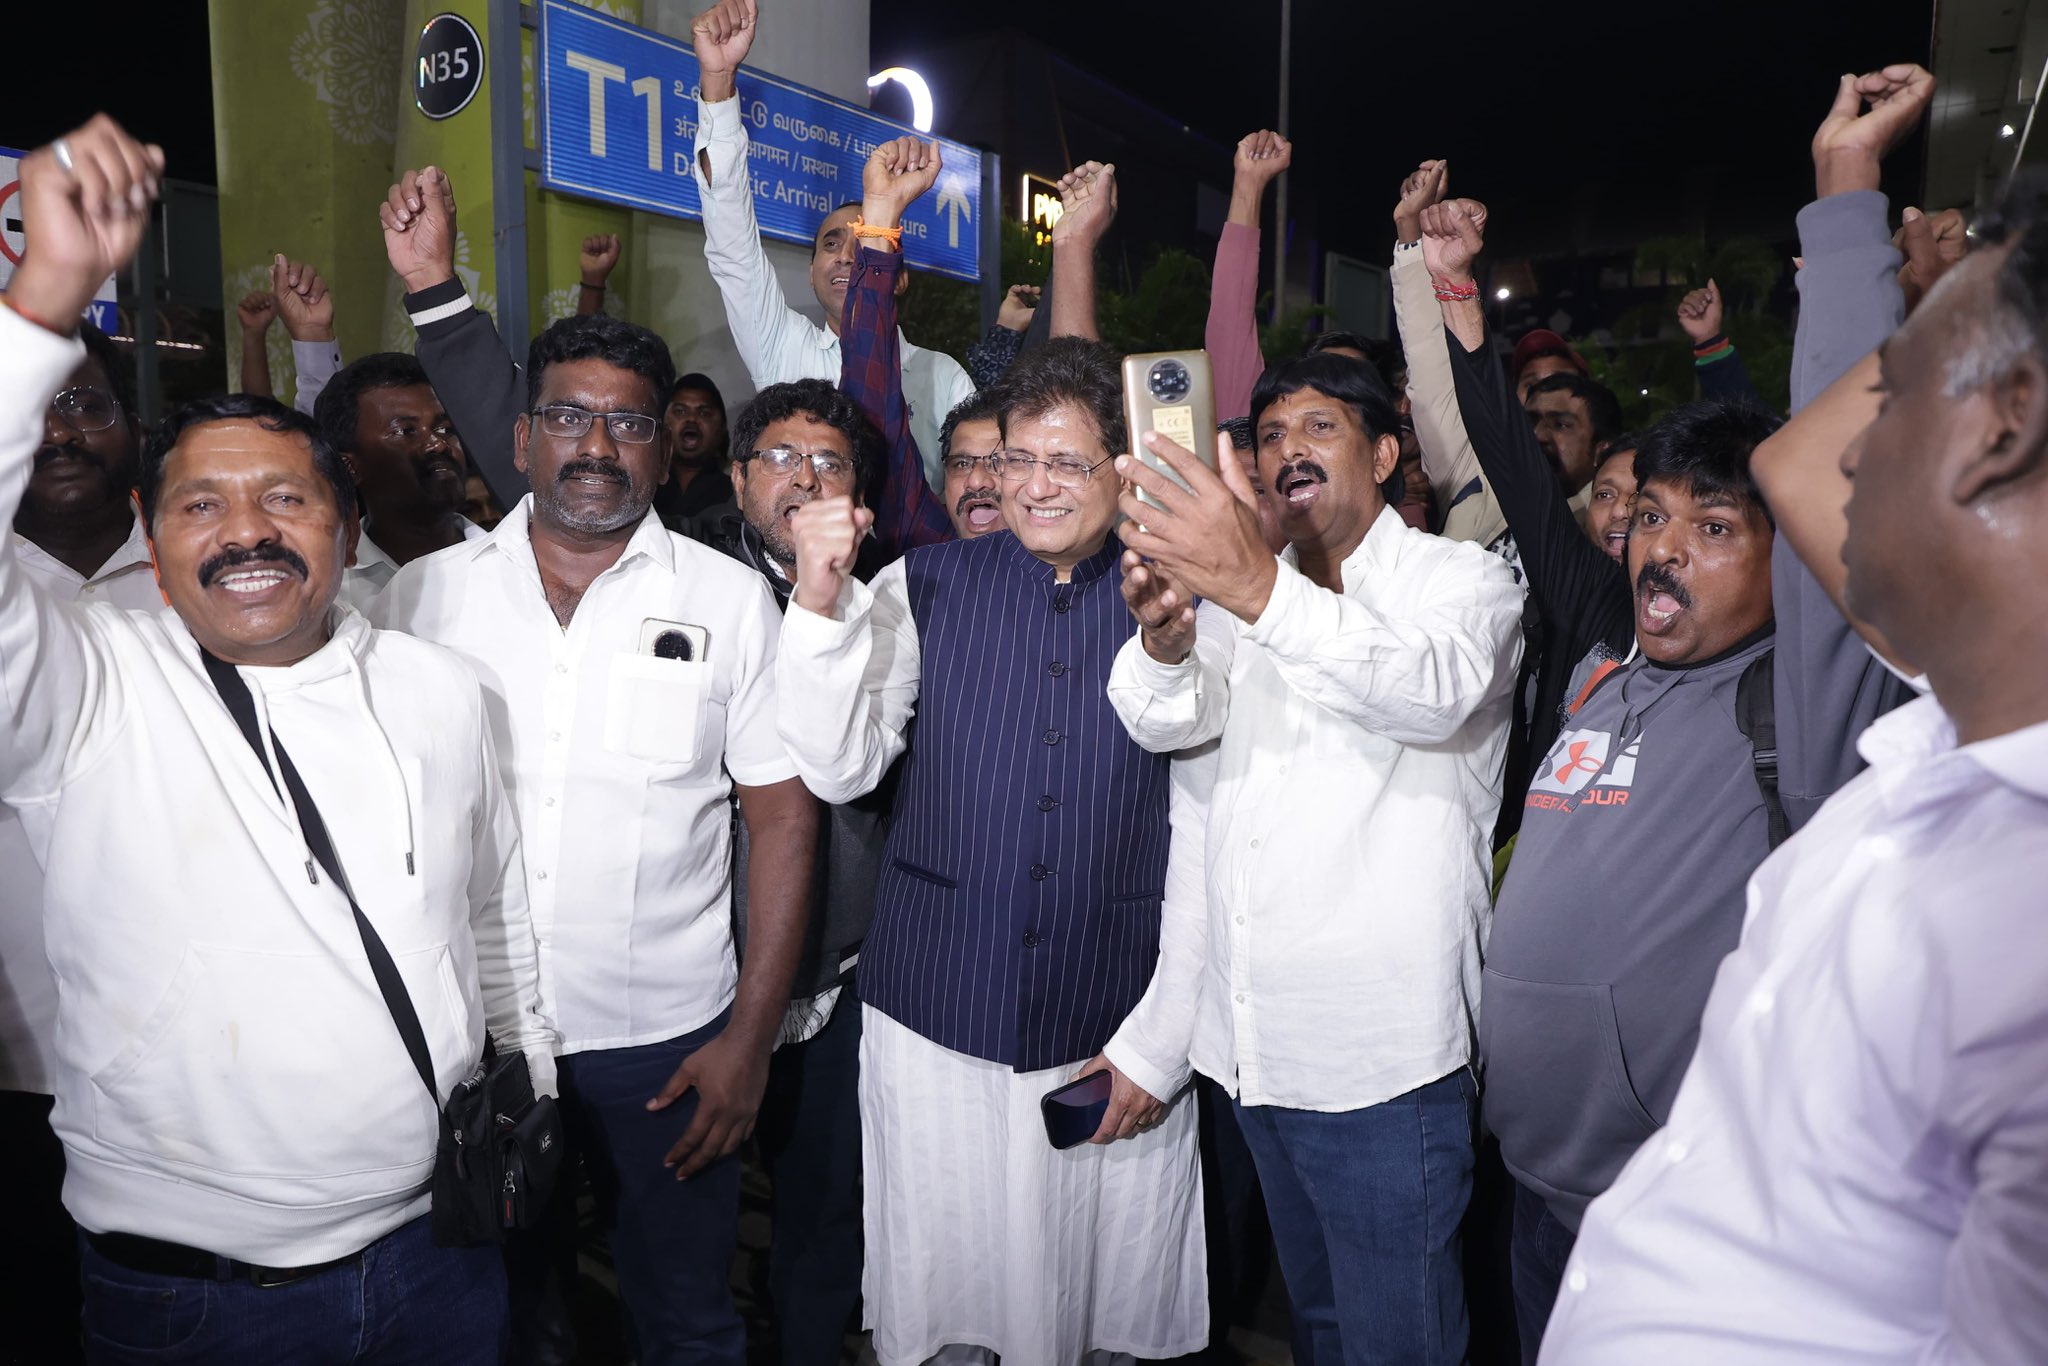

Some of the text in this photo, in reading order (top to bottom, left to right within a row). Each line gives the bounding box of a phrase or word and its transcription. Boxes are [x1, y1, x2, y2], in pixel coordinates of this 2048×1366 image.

[420, 47, 469, 88] N35
[566, 50, 664, 172] T1
[773, 112, 841, 148] வருகை
[774, 179, 833, 214] Arrival
